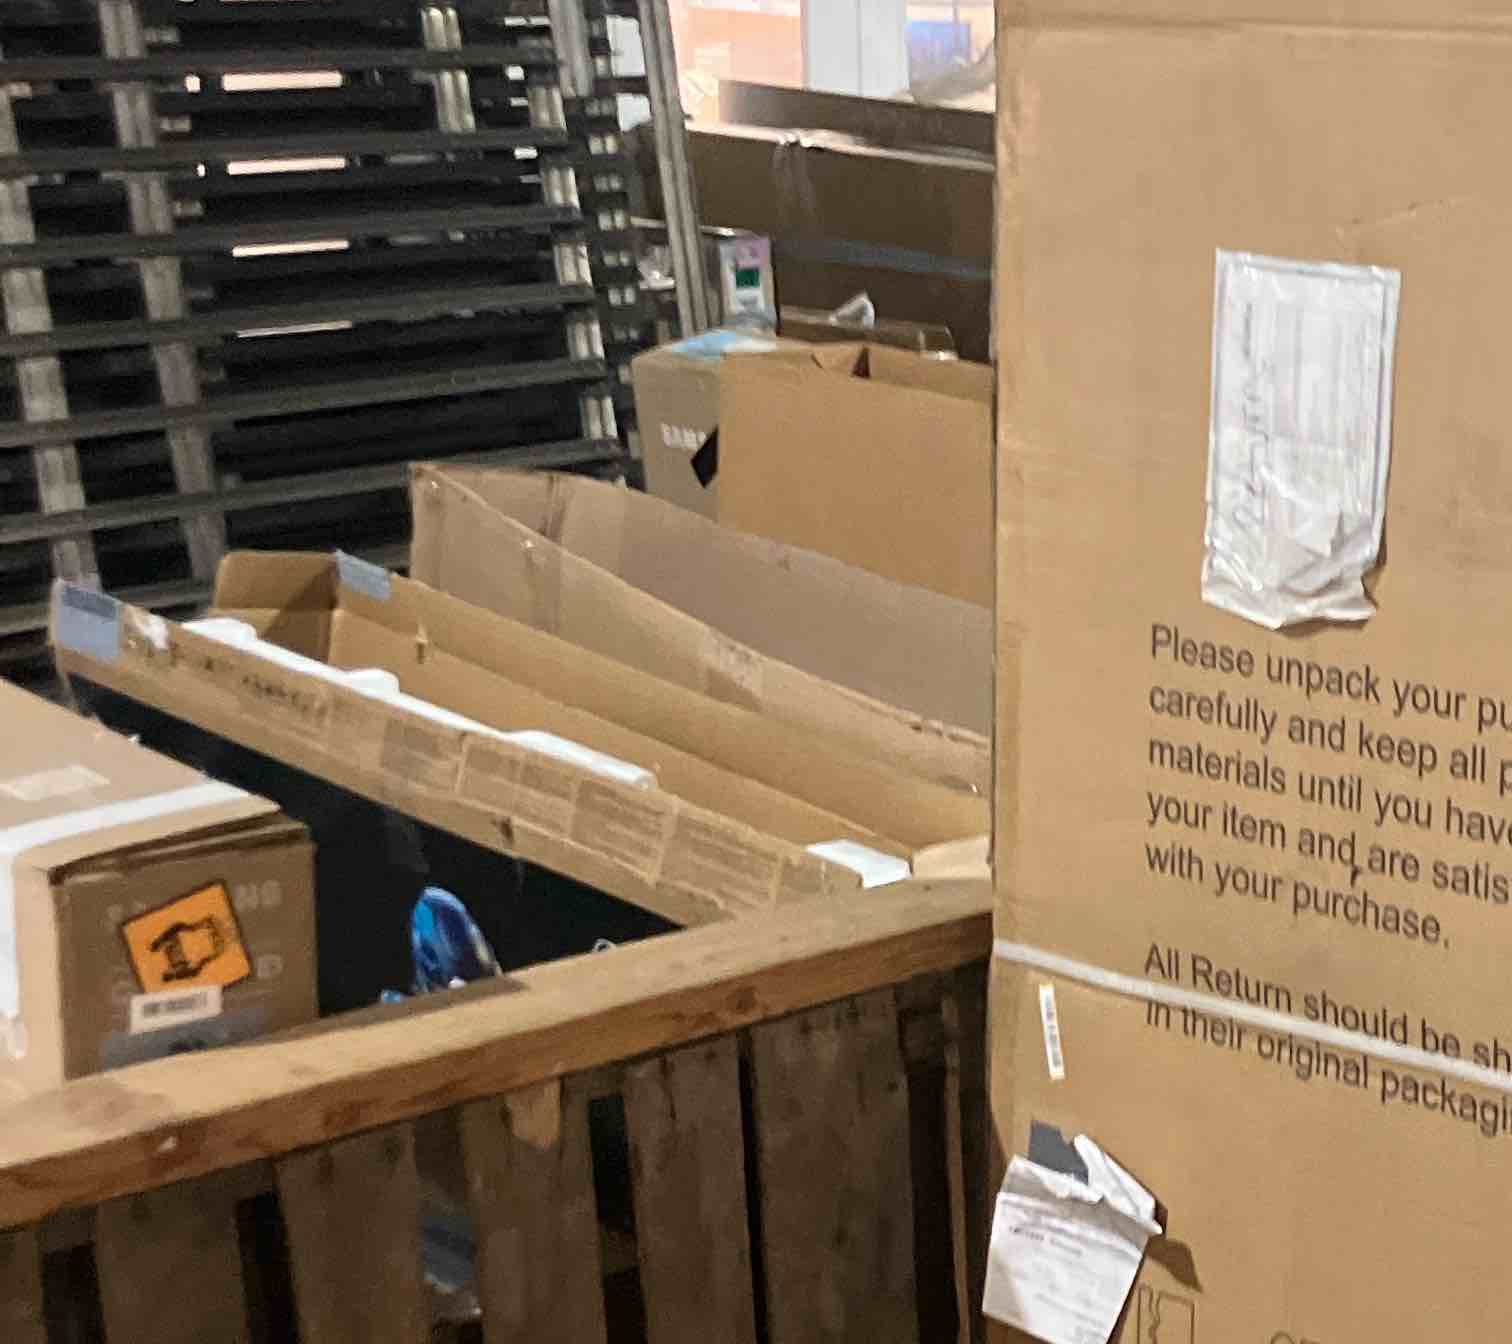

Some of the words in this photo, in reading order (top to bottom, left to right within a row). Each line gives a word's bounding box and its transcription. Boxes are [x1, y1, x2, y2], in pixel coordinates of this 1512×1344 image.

[1150, 623, 1255, 678] Please
[1266, 646, 1381, 705] unpack
[1393, 676, 1466, 720] your
[1149, 682, 1278, 746] carefully
[1288, 711, 1345, 753] and
[1357, 721, 1437, 778] keep
[1450, 743, 1486, 785] all
[1149, 736, 1286, 796] materials
[1298, 770, 1362, 814] until
[1374, 785, 1432, 830] you
[1146, 790, 1212, 832] your
[1222, 800, 1286, 849] item
[1297, 823, 1356, 866] and
[1367, 846, 1420, 881] are
[1145, 841, 1204, 884] with
[1214, 862, 1283, 904] your
[1293, 872, 1450, 949] purchase.
[1144, 942, 1181, 982] All
[1191, 953, 1292, 1013] Return
[1303, 990, 1408, 1047] should
[1421, 1017, 1460, 1057] be
[1181, 1006, 1243, 1052] their
[1257, 1032, 1369, 1090] original
